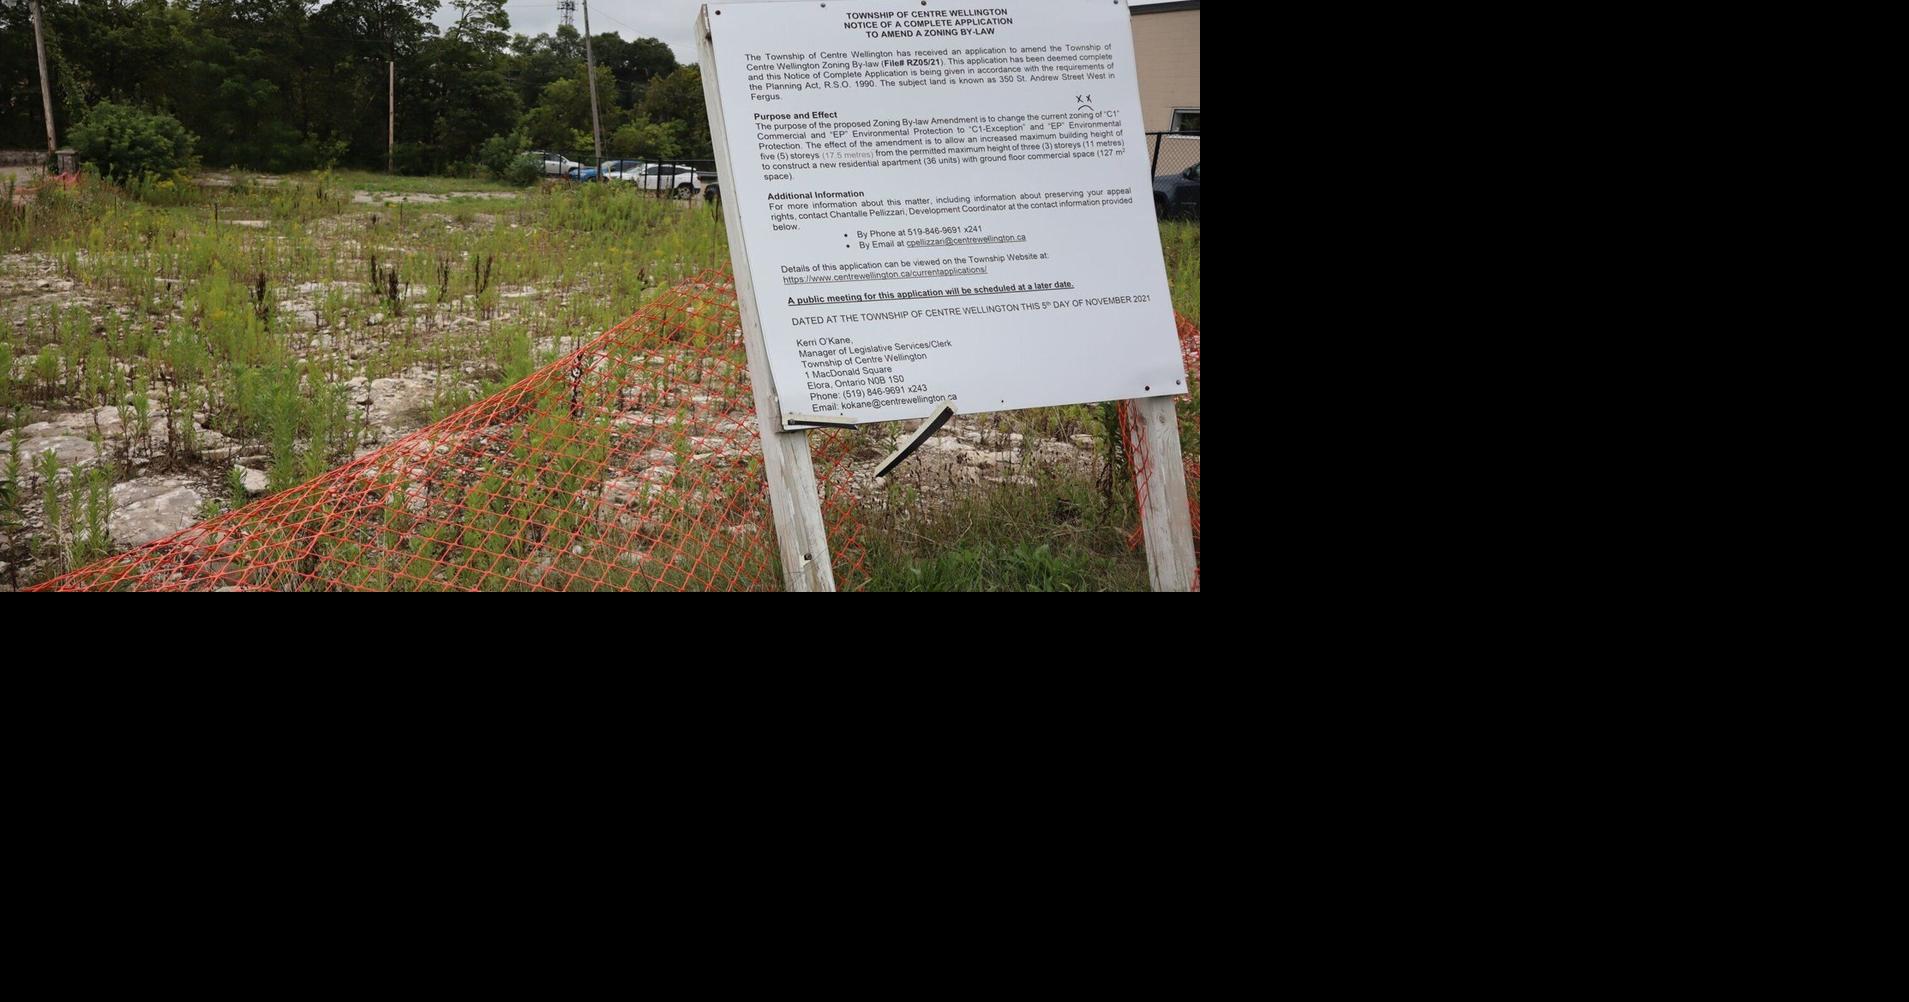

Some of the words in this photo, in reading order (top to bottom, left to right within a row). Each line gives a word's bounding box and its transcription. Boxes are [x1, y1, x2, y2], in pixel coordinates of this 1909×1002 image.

[846, 11, 894, 20] TOWNSHIP
[896, 10, 908, 18] OF
[911, 9, 947, 18] CENTRE
[949, 8, 1007, 17] WELLINGTON
[844, 21, 878, 30] NOTICE
[880, 20, 892, 28] OF
[903, 19, 952, 28] COMPLETE
[954, 17, 1013, 26] APPLICATION
[865, 30, 878, 38] TO
[881, 29, 913, 38] AMEND
[924, 28, 958, 37] ZONING
[960, 27, 995, 36] BY-LAW
[744, 53, 761, 61] The
[765, 52, 805, 61] Township
[808, 51, 816, 59] of
[820, 51, 847, 59] Centre
[851, 50, 893, 59] Wellington
[896, 49, 911, 57] has
[914, 47, 948, 56] received
[964, 46, 1006, 56] application
[1020, 44, 1046, 53] amend
[1049, 44, 1062, 52] the
[1065, 43, 1101, 52] Township
[1104, 42, 1111, 50] of
[746, 63, 774, 71] Centre
[776, 61, 820, 71] Wellington
[822, 60, 850, 69] Zoning
[852, 59, 879, 69] By-law
[881, 58, 904, 68] (File#
[947, 57, 964, 65] This
[966, 55, 1008, 66] application
[1009, 55, 1024, 63] has
[1025, 54, 1045, 62] been
[1046, 53, 1077, 62] deemed
[1079, 52, 1112, 62] complete
[754, 112, 791, 122] Purpose
[793, 111, 810, 119] and
[812, 111, 837, 119] Effect
[805, 140, 821, 148] The
[824, 139, 846, 147] effect
[849, 138, 857, 146] of
[859, 138, 872, 146] the
[875, 136, 922, 145] amendment
[925, 136, 932, 144] is
[944, 135, 965, 143] allow
[980, 132, 1017, 142] increased
[1019, 131, 1056, 140] maximum
[1058, 130, 1088, 139] building
[1090, 129, 1113, 138] height
[1115, 128, 1123, 136] of
[767, 191, 812, 200] Additional
[814, 190, 864, 199] Information
[769, 202, 783, 211] For
[812, 199, 857, 209] information
[861, 198, 883, 206] about
[886, 197, 901, 205] this
[935, 194, 970, 203] including
[973, 192, 1016, 201] information
[1019, 191, 1041, 199] about
[1043, 189, 1084, 200] preserving
[1086, 189, 1103, 198] your
[1106, 186, 1131, 197] appeal
[771, 212, 796, 222] rights,
[798, 211, 828, 219] contact
[829, 209, 867, 218] Chantalle
[869, 207, 907, 216] Pellizzari,
[908, 204, 960, 215] Development
[961, 203, 1006, 212] Coordinator
[1008, 202, 1015, 210] at
[1016, 201, 1029, 209] the
[1030, 200, 1058, 209] contact
[1058, 198, 1100, 207] information
[1102, 196, 1133, 207] provided
[857, 230, 868, 239] By
[869, 229, 896, 237] Phone
[897, 228, 906, 236] at
[907, 225, 961, 236] 519-846-9691
[963, 224, 982, 233] x241
[859, 240, 870, 250] By
[872, 239, 894, 248] Email
[896, 239, 904, 247] at
[906, 234, 1026, 248] cpellizzari@centrewellington.ca
[781, 264, 810, 273] Details
[812, 263, 820, 271] of
[822, 263, 837, 271] this
[839, 260, 882, 271] application
[900, 259, 911, 267] be
[912, 257, 940, 266] viewed
[954, 256, 966, 264] the
[968, 254, 1005, 263] Township
[1006, 252, 1038, 261] Website
[782, 265, 987, 285] https://www.centrewellington.ca/currentapplications/
[797, 295, 824, 306] public
[827, 293, 862, 302] meeting
[864, 292, 876, 300] for
[878, 291, 894, 299] this
[897, 288, 943, 300] application
[945, 287, 959, 296] will
[961, 286, 971, 295] be
[973, 284, 1016, 294] scheduled
[1017, 283, 1026, 291] at
[1034, 282, 1052, 290] later
[1054, 281, 1074, 289] date.
[791, 316, 824, 326] DATED
[826, 315, 837, 323] AT
[840, 313, 859, 323] THE
[860, 310, 909, 321] TOWNSHIP
[910, 309, 923, 318] OF
[925, 307, 961, 317] CENTRE
[962, 303, 1019, 314] WELLINGTON
[1020, 301, 1040, 311] THIS
[1052, 299, 1070, 308] DAY
[1071, 298, 1083, 307] OF
[1085, 295, 1132, 306] NOVEMBER
[1133, 294, 1150, 303] 2021
[796, 338, 817, 347] Kerri
[818, 337, 853, 345] O'Kane,
[798, 349, 836, 358] Manager
[838, 346, 847, 355] of
[848, 344, 892, 355] Legislative
[894, 339, 952, 351] Services/Clerk
[801, 358, 842, 368] Township
[844, 357, 852, 365] of
[854, 356, 883, 365] Centre
[884, 353, 927, 363] Wellington
[812, 367, 860, 378] MacDonald
[862, 366, 892, 376] Square
[807, 381, 832, 390] Elora,
[834, 378, 866, 388] Ontario
[810, 392, 840, 401] Phone:
[842, 389, 865, 400] (519)
[866, 386, 905, 396] 846-9691
[907, 384, 927, 393] x243
[812, 402, 839, 412] Email:
[841, 394, 957, 410] kokane@centrewellington.ca
